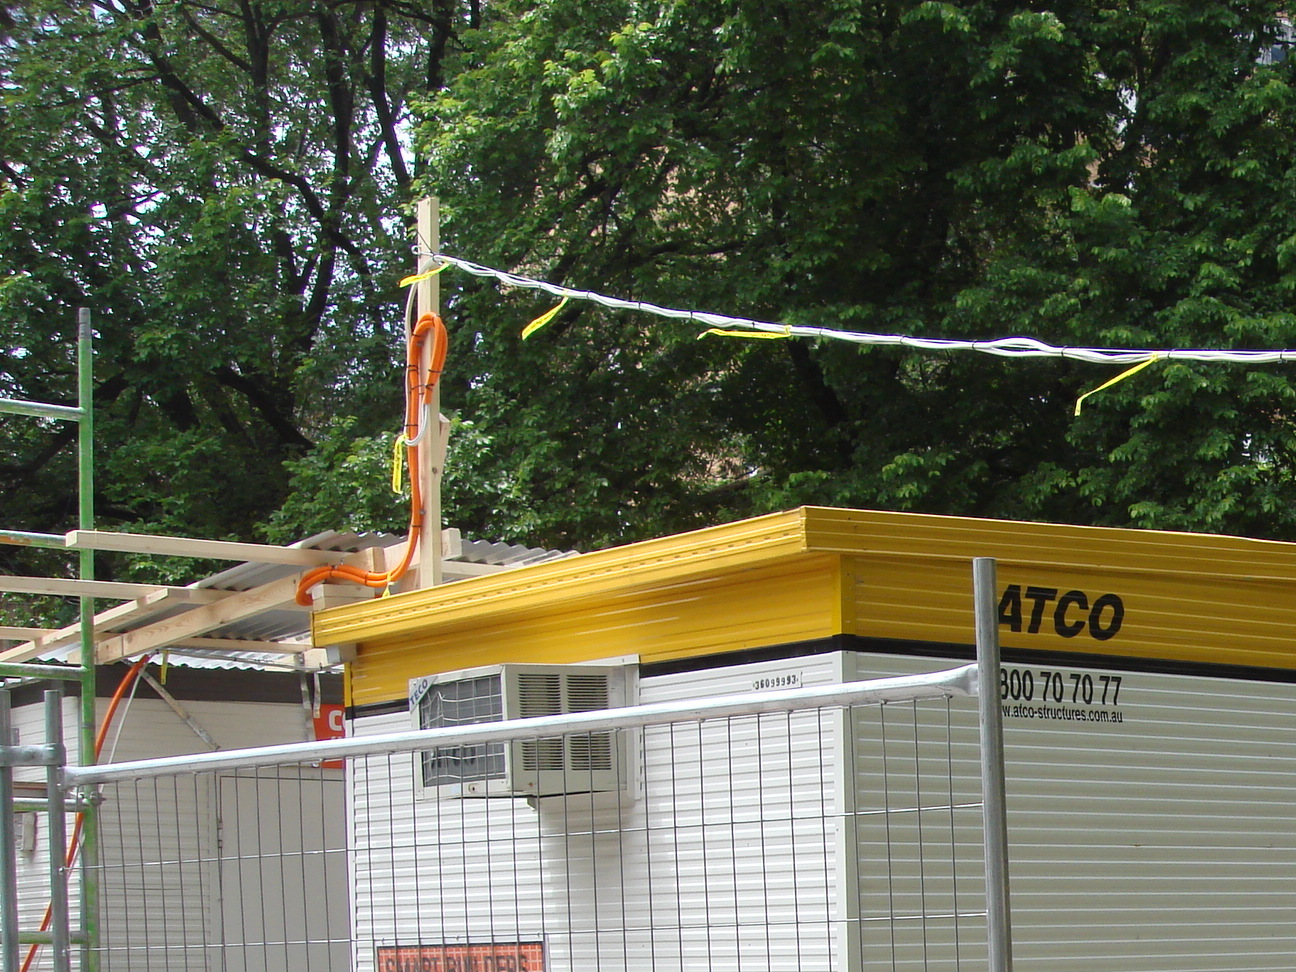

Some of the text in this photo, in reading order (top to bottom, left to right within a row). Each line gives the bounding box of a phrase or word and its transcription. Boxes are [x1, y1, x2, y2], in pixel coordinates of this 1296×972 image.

[998, 584, 1125, 641] ATCO
[410, 679, 429, 705] TECO
[1000, 667, 1122, 706] 800 70 70 77
[1002, 703, 1123, 723] w.atco-structures.com.au
